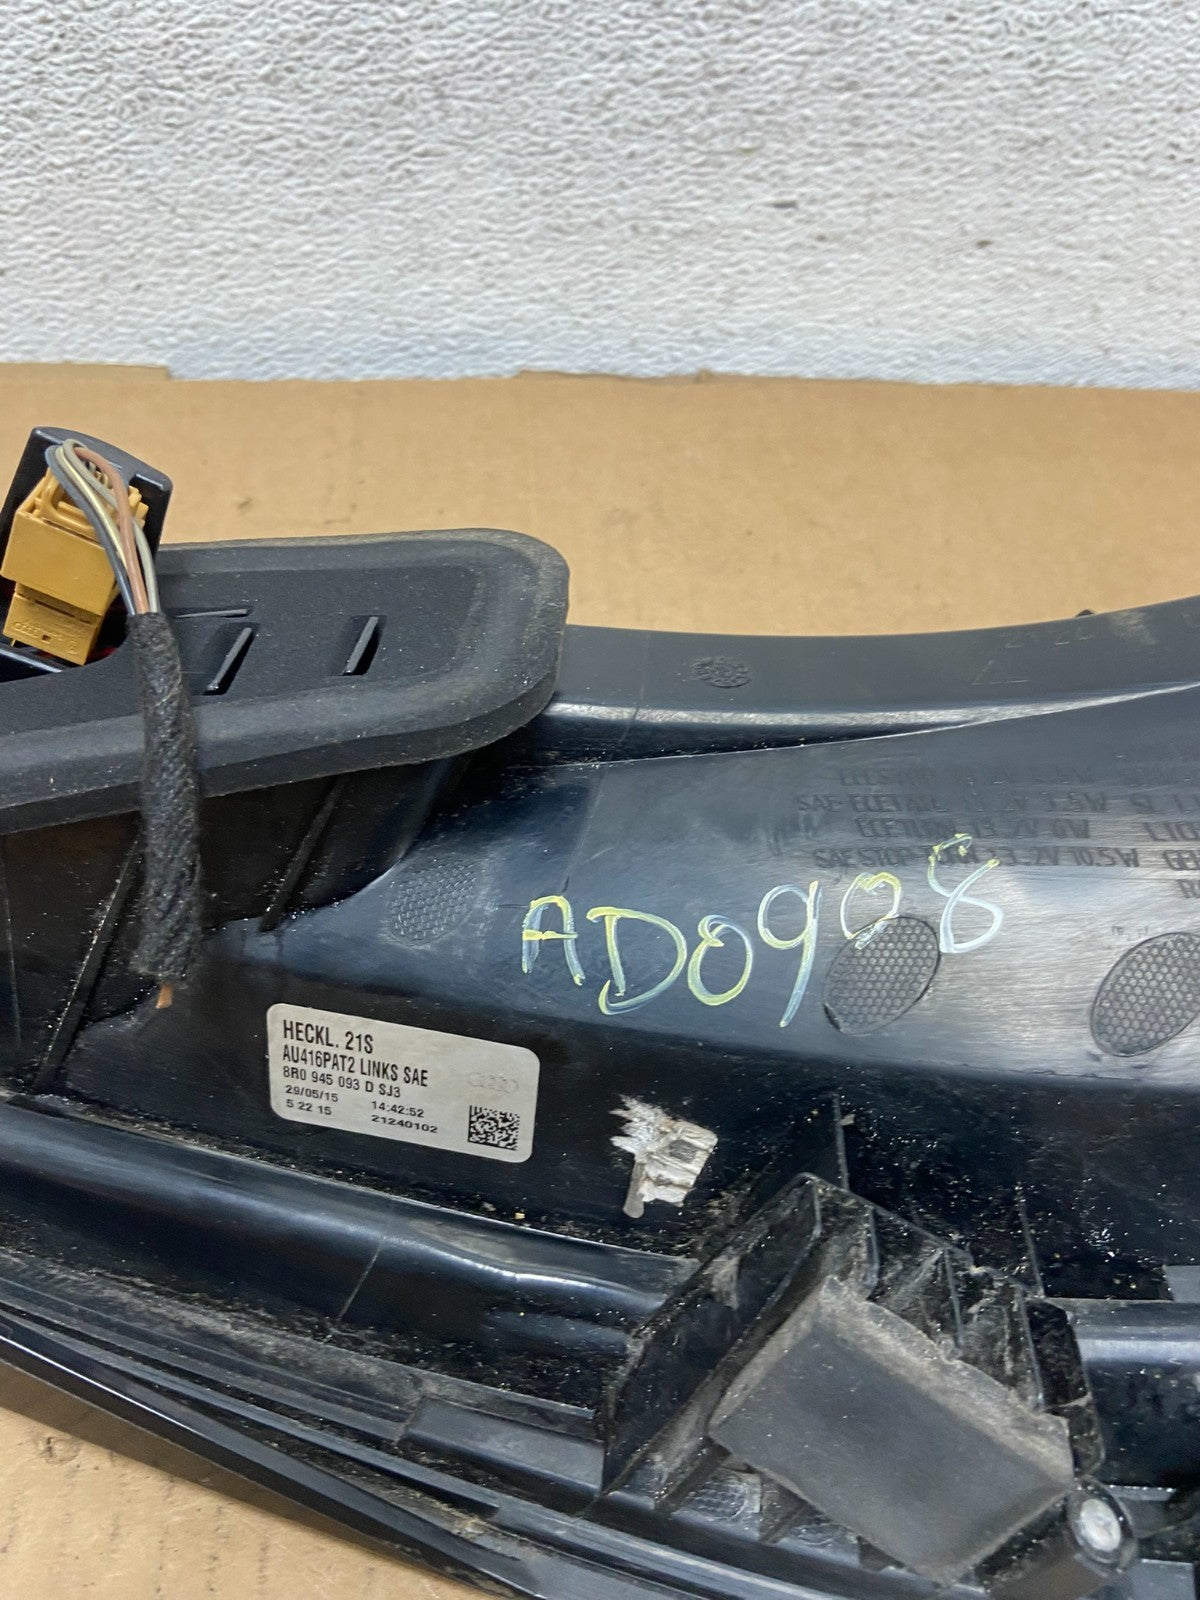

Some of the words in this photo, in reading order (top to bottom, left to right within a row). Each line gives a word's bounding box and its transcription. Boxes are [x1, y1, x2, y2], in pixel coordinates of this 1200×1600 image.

[283, 1019, 340, 1049] HECKL.
[345, 1031, 374, 1054] 21S
[283, 1044, 356, 1073] AU416PAT2
[360, 1058, 398, 1082] LINKS
[403, 1066, 428, 1087] SAE
[283, 1066, 307, 1081] 8R0
[311, 1070, 333, 1086] 945
[338, 1075, 360, 1090] 093
[365, 1080, 374, 1093] D
[378, 1083, 401, 1098] SJ3
[285, 1084, 339, 1103] 29/05/15
[286, 1099, 294, 1109] 5
[297, 1101, 314, 1113] 22
[318, 1105, 332, 1115] 15
[371, 1101, 424, 1118] 14:42:52
[371, 1114, 438, 1134] 21240102
